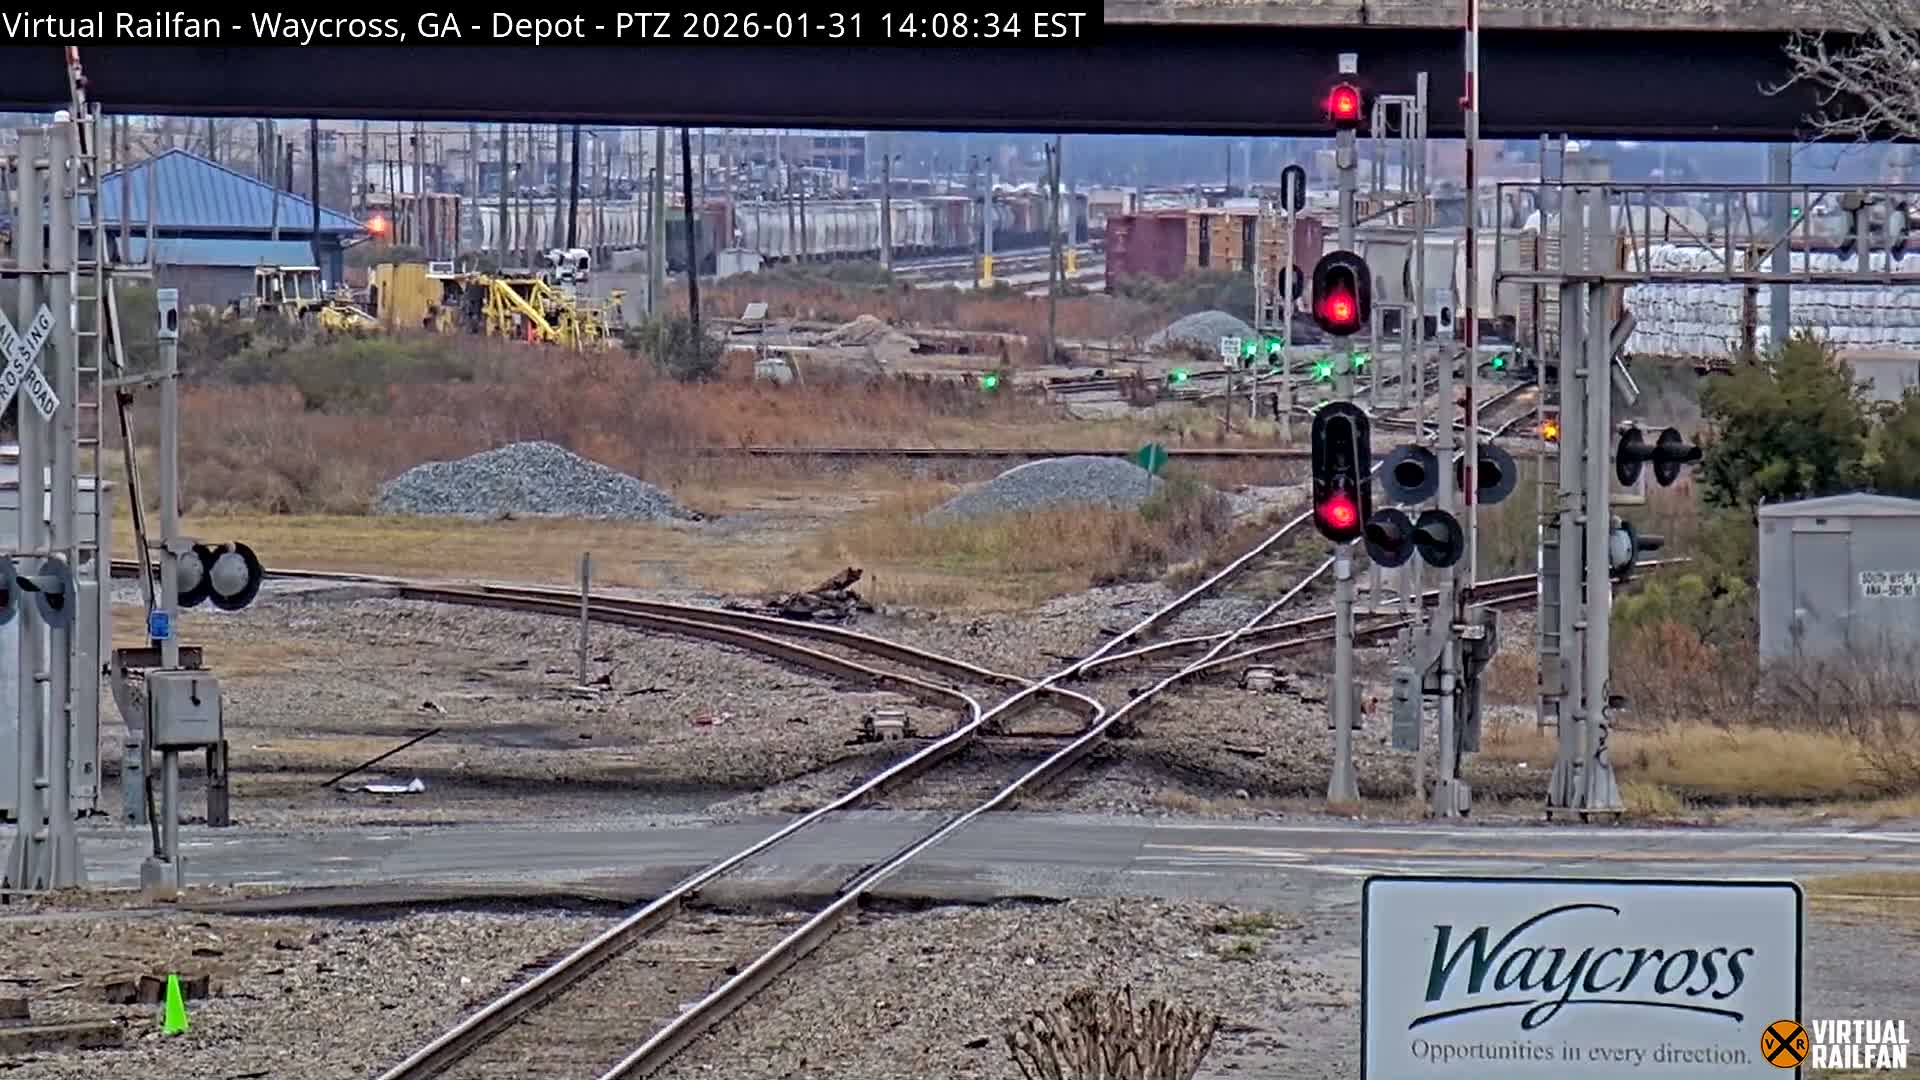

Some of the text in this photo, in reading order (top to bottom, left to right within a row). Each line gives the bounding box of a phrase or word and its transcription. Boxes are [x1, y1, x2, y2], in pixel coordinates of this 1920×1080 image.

[0, 314, 49, 400] ROSSING
[0, 324, 55, 415] AIL ROAD
[1424, 904, 1755, 1030] Waycross
[1411, 1038, 1752, 1066] Opportunities in every direction.
